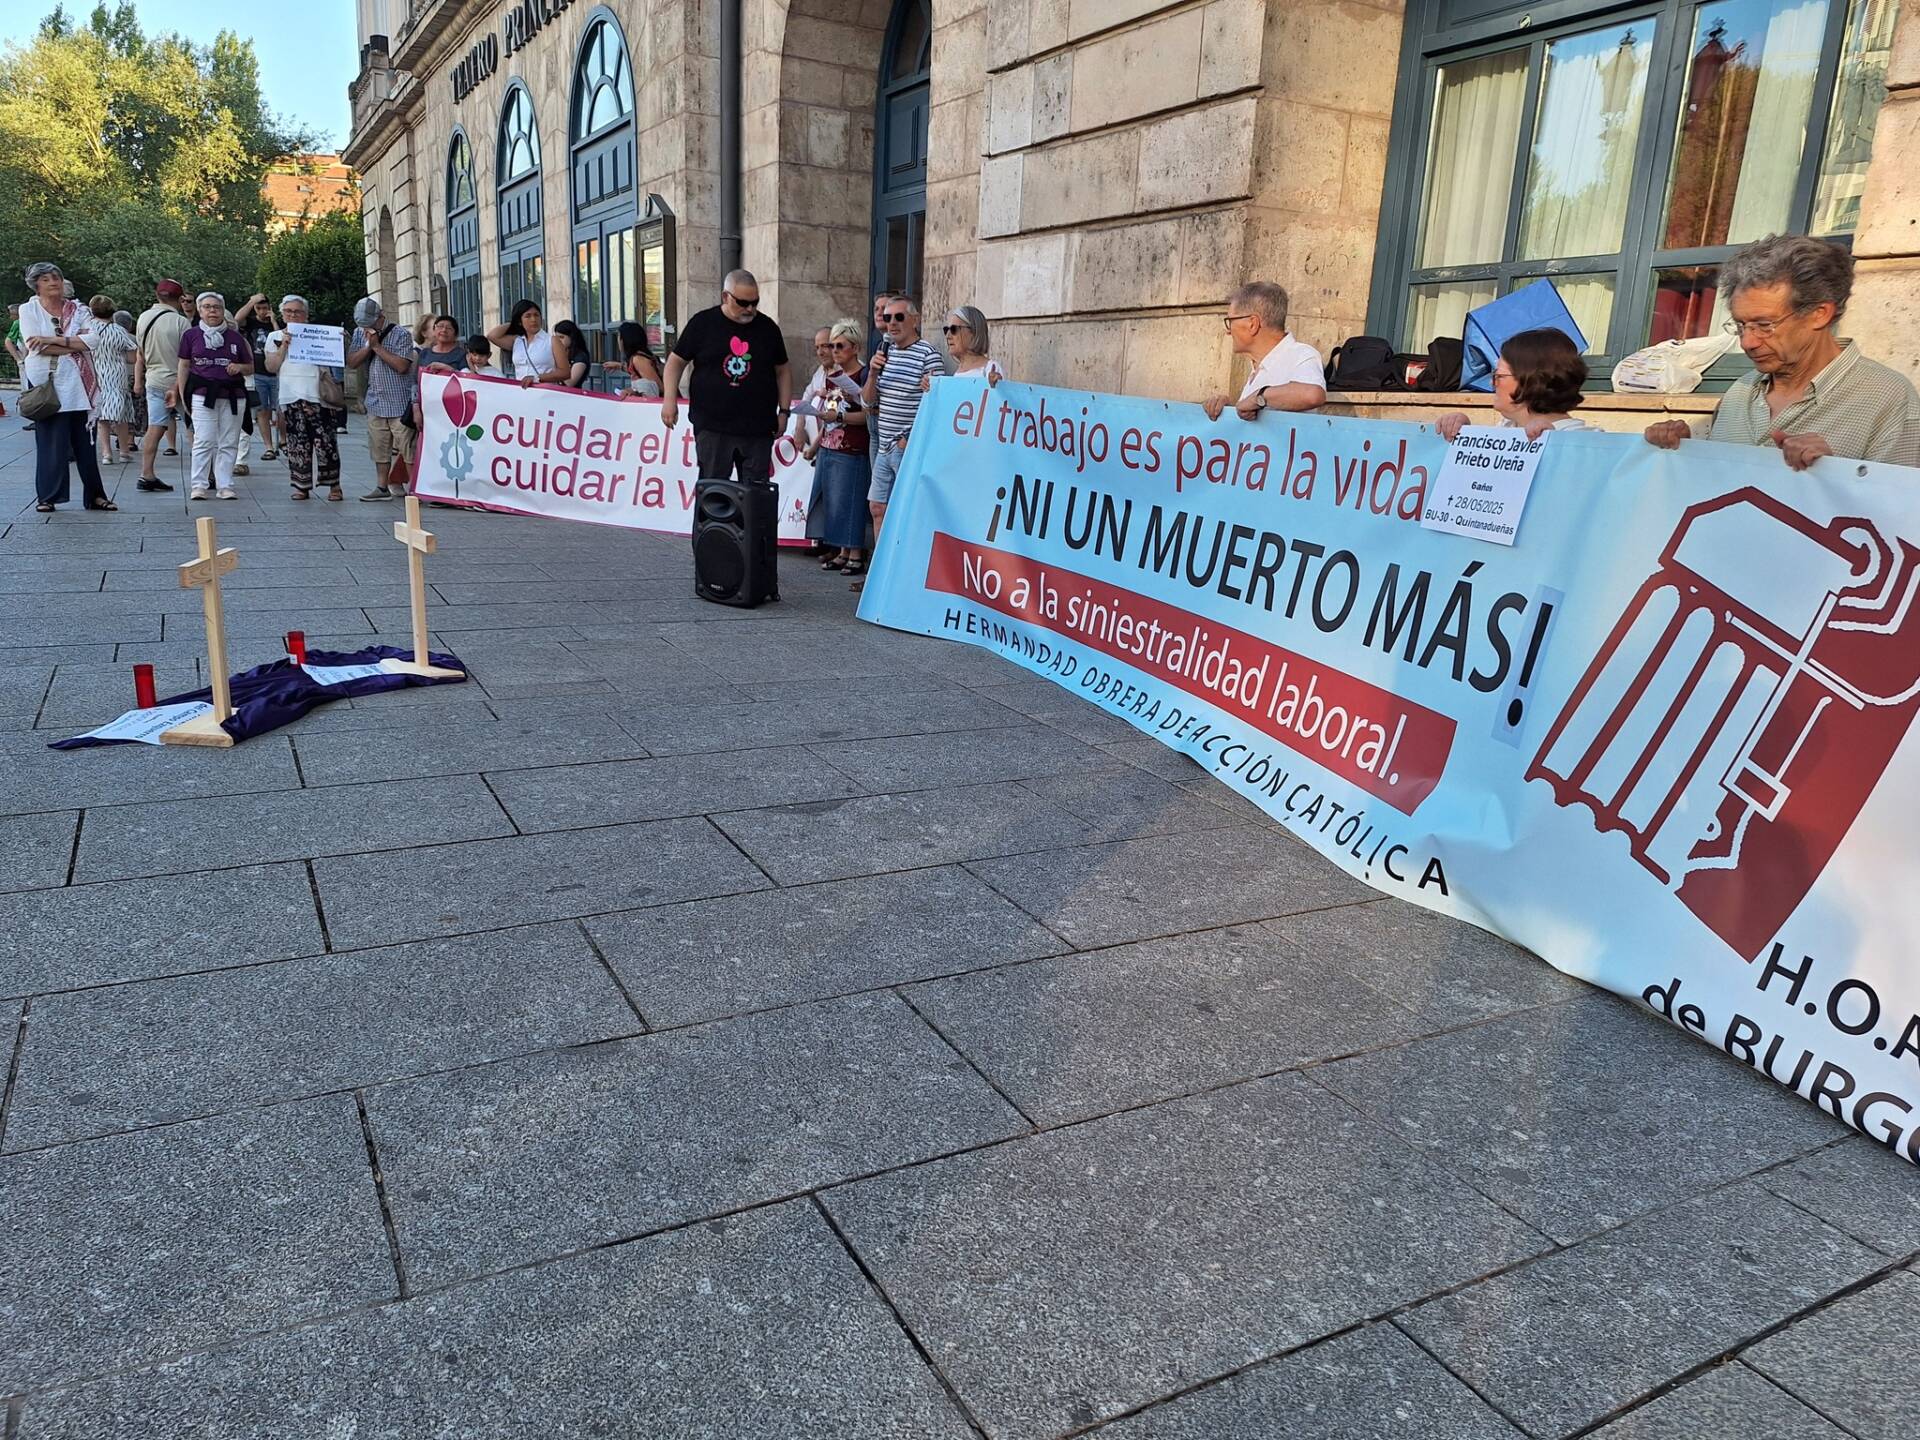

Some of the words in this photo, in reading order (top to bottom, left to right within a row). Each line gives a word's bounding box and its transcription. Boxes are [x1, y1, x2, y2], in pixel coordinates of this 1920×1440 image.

[450, 32, 499, 105] TEATRO
[303, 327, 329, 335] América
[492, 410, 632, 461] cuidar
[639, 427, 671, 465] el
[953, 389, 989, 438] el
[997, 398, 1109, 474] trabajo
[1120, 431, 1162, 474] es
[1175, 434, 1272, 492] para
[1280, 428, 1318, 500] la
[1333, 438, 1428, 522] vida
[1451, 433, 1506, 451] Francisco
[1508, 437, 1543, 454] Javier
[1455, 450, 1490, 468] Prieto
[1493, 454, 1524, 472] Ureña
[491, 453, 625, 503] cuidar
[632, 466, 665, 508] la
[1455, 495, 1504, 515] 28/05/2025
[1425, 508, 1449, 522] BU-30
[1455, 515, 1514, 535] Quintanadueñas
[986, 474, 1054, 543] ¡NI
[1065, 490, 1133, 562] UN
[1138, 505, 1360, 633] MUERTO
[1362, 560, 1553, 727] MÁS!
[962, 550, 1001, 600] No
[1008, 574, 1030, 609] a
[1038, 571, 1058, 620] la
[1066, 587, 1272, 712] siniestralidad
[1268, 661, 1407, 786] laboral.
[943, 608, 1078, 677] HERMANDAD
[1081, 666, 1162, 722] OBRERA
[1284, 784, 1450, 896] CATÓLICA
[1642, 978, 1706, 1038] de
[1724, 1014, 1920, 1168] BURG
